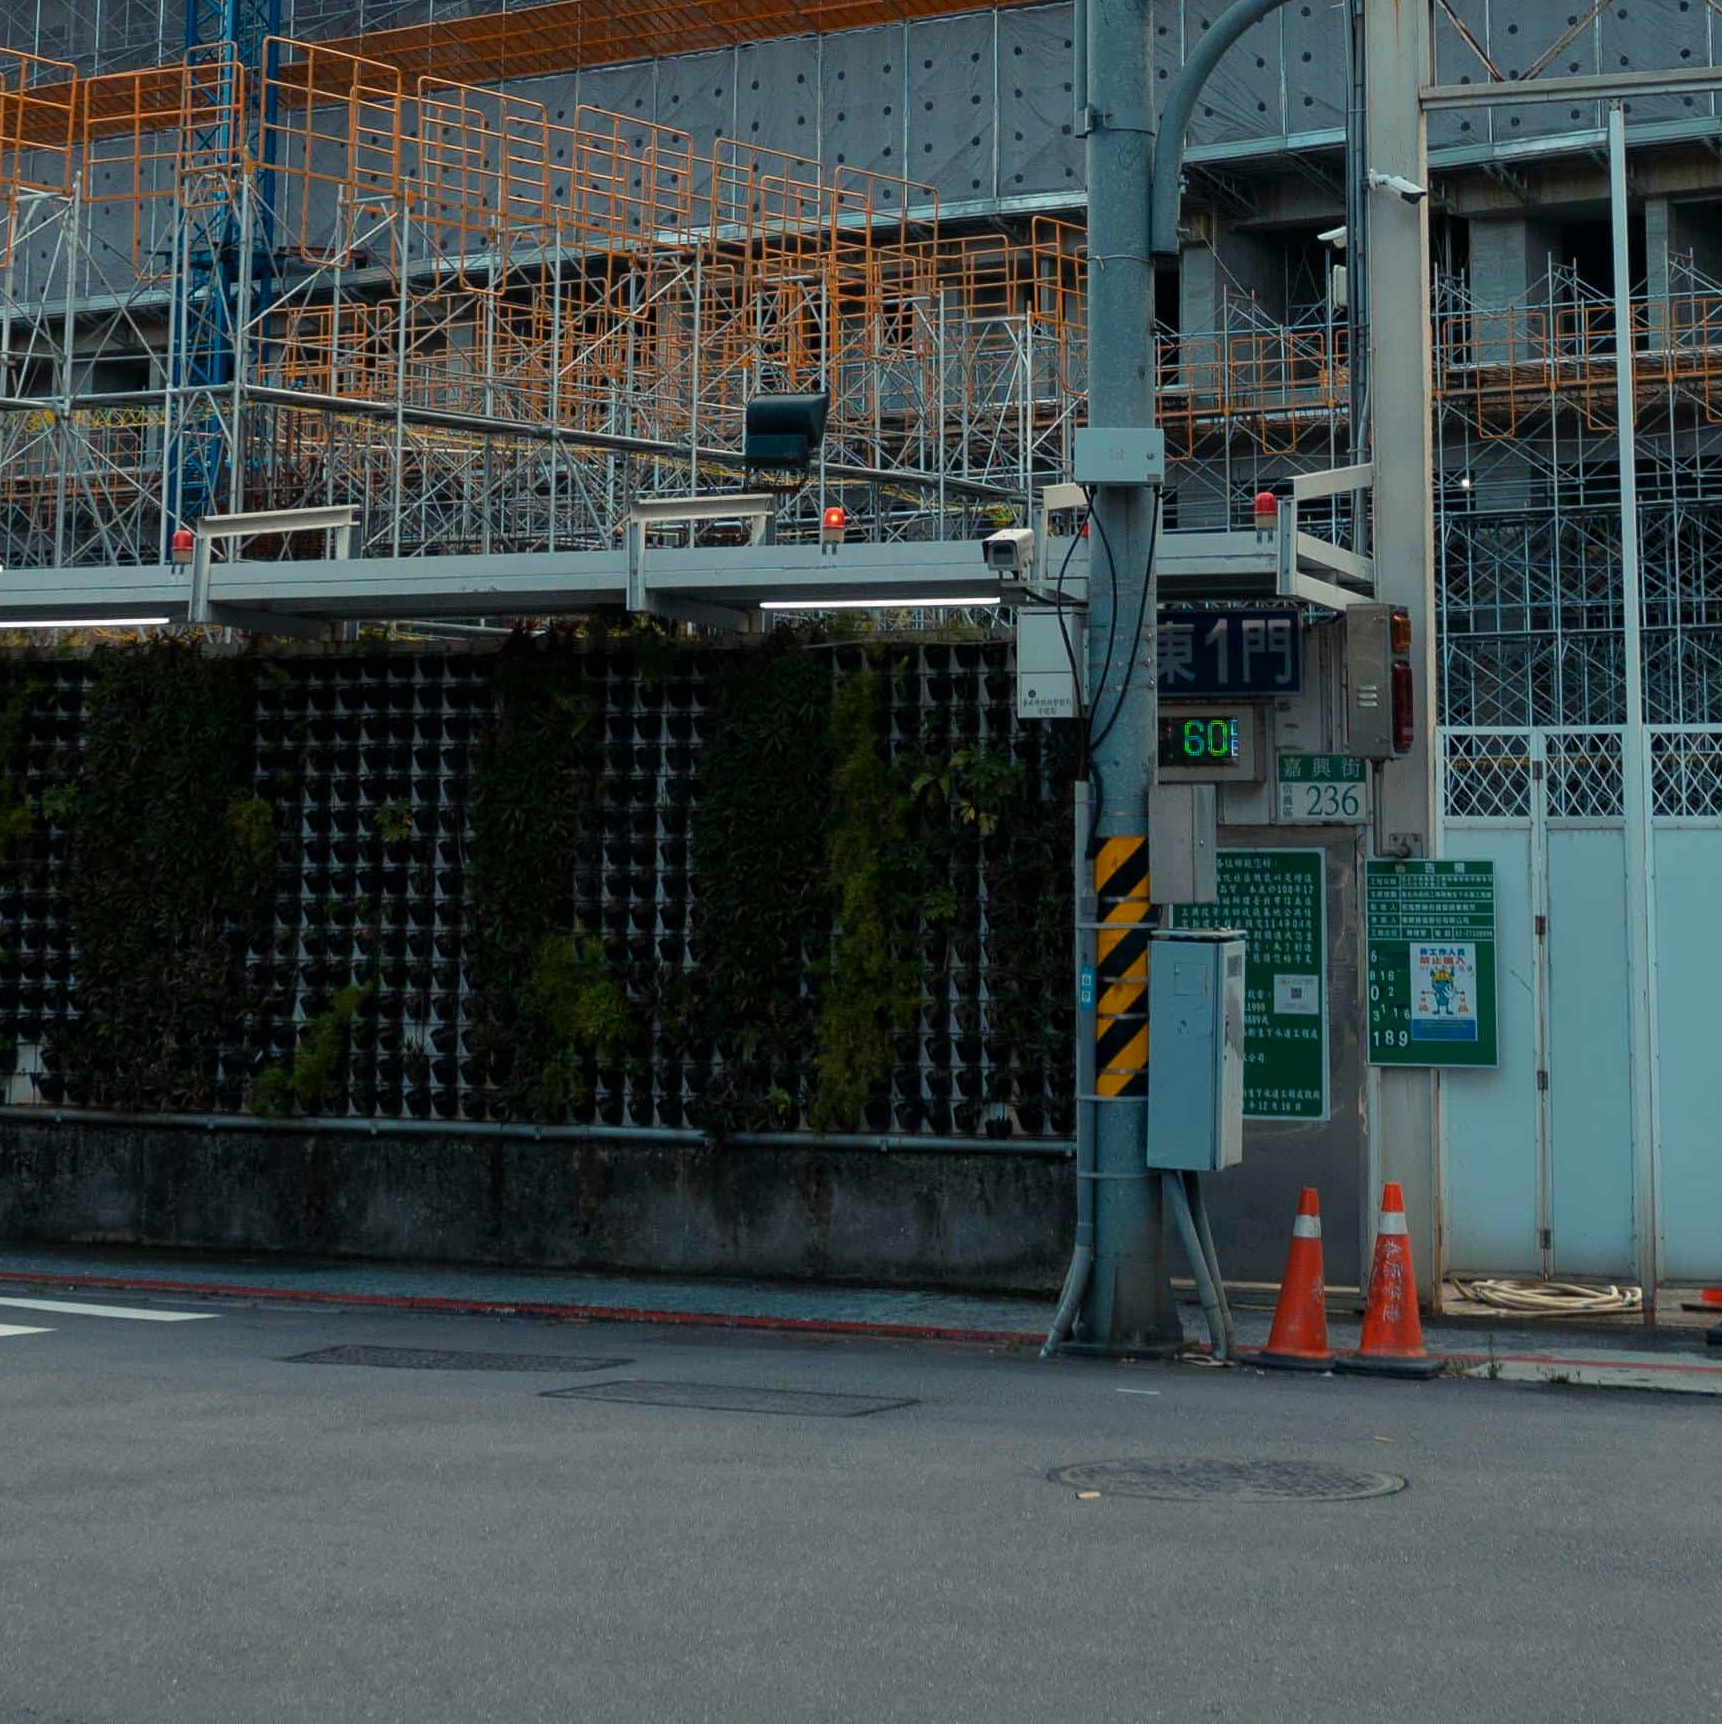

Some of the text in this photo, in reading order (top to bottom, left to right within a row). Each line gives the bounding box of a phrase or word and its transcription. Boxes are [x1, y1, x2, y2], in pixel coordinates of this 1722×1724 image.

[1156, 618, 1292, 684] 東1門
[1184, 719, 1228, 757] 60
[1283, 757, 1361, 778] 嘉興街
[1305, 784, 1360, 817] 236
